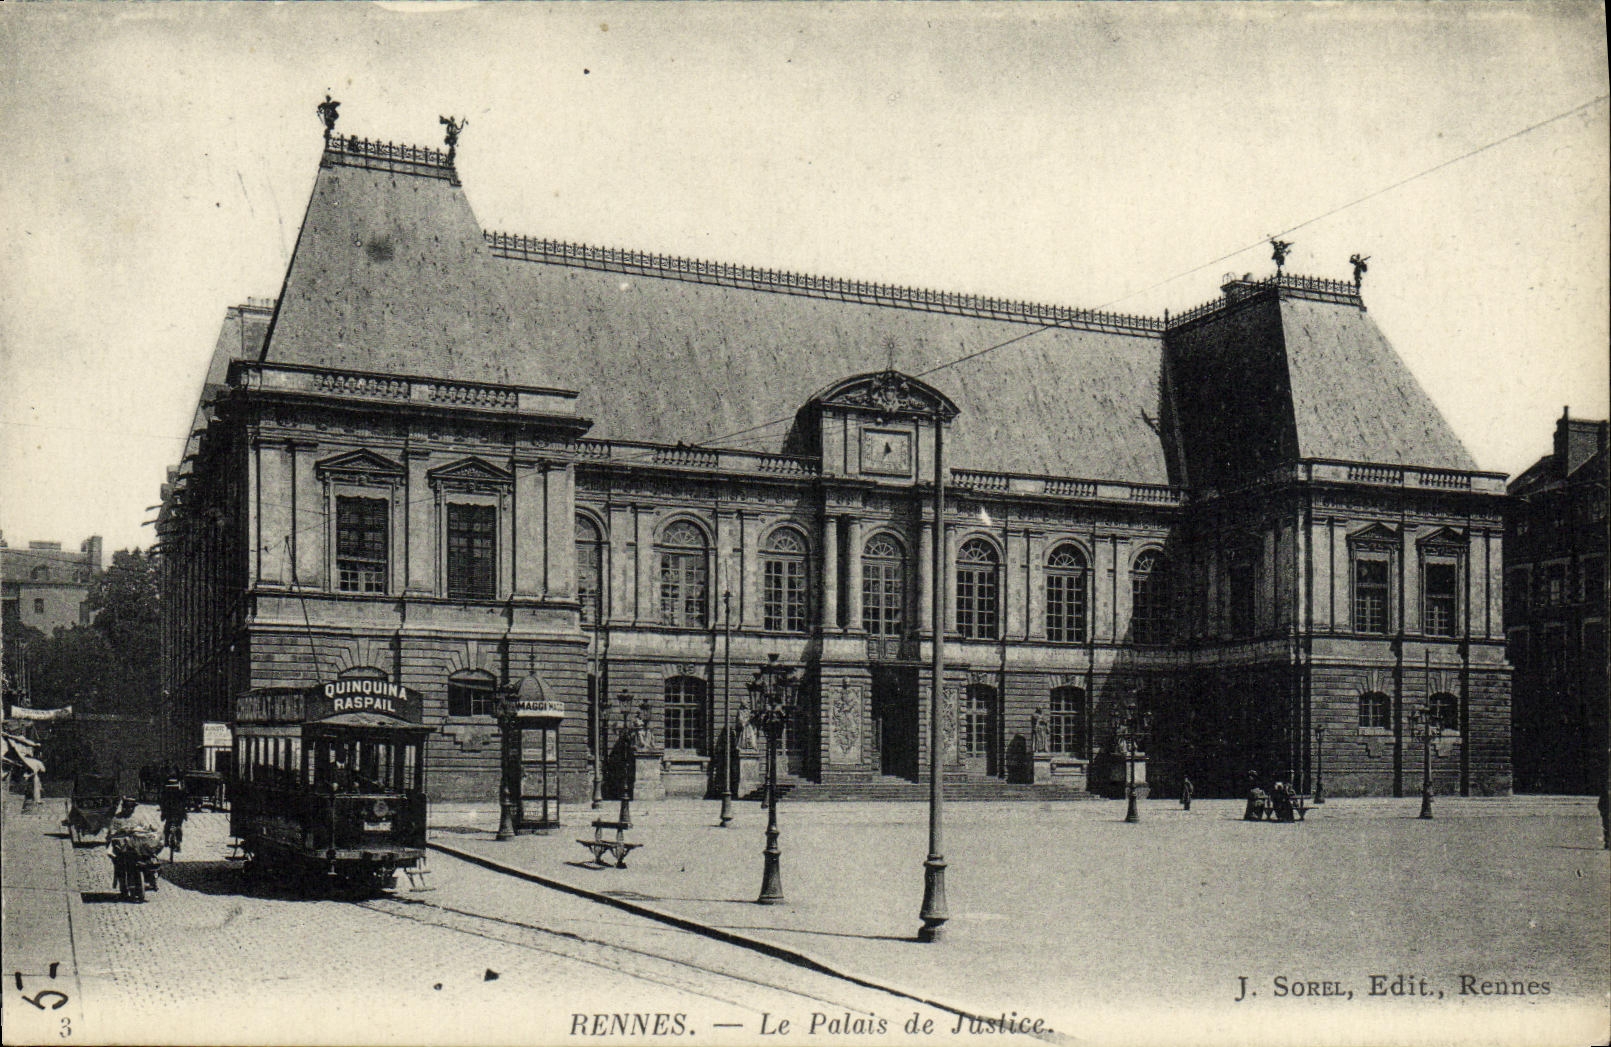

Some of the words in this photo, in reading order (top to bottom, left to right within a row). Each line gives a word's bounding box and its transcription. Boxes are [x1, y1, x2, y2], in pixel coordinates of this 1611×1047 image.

[324, 679, 408, 701] QUINQUINA
[333, 696, 396, 713] RASPAIL
[516, 701, 548, 712] MAGGI
